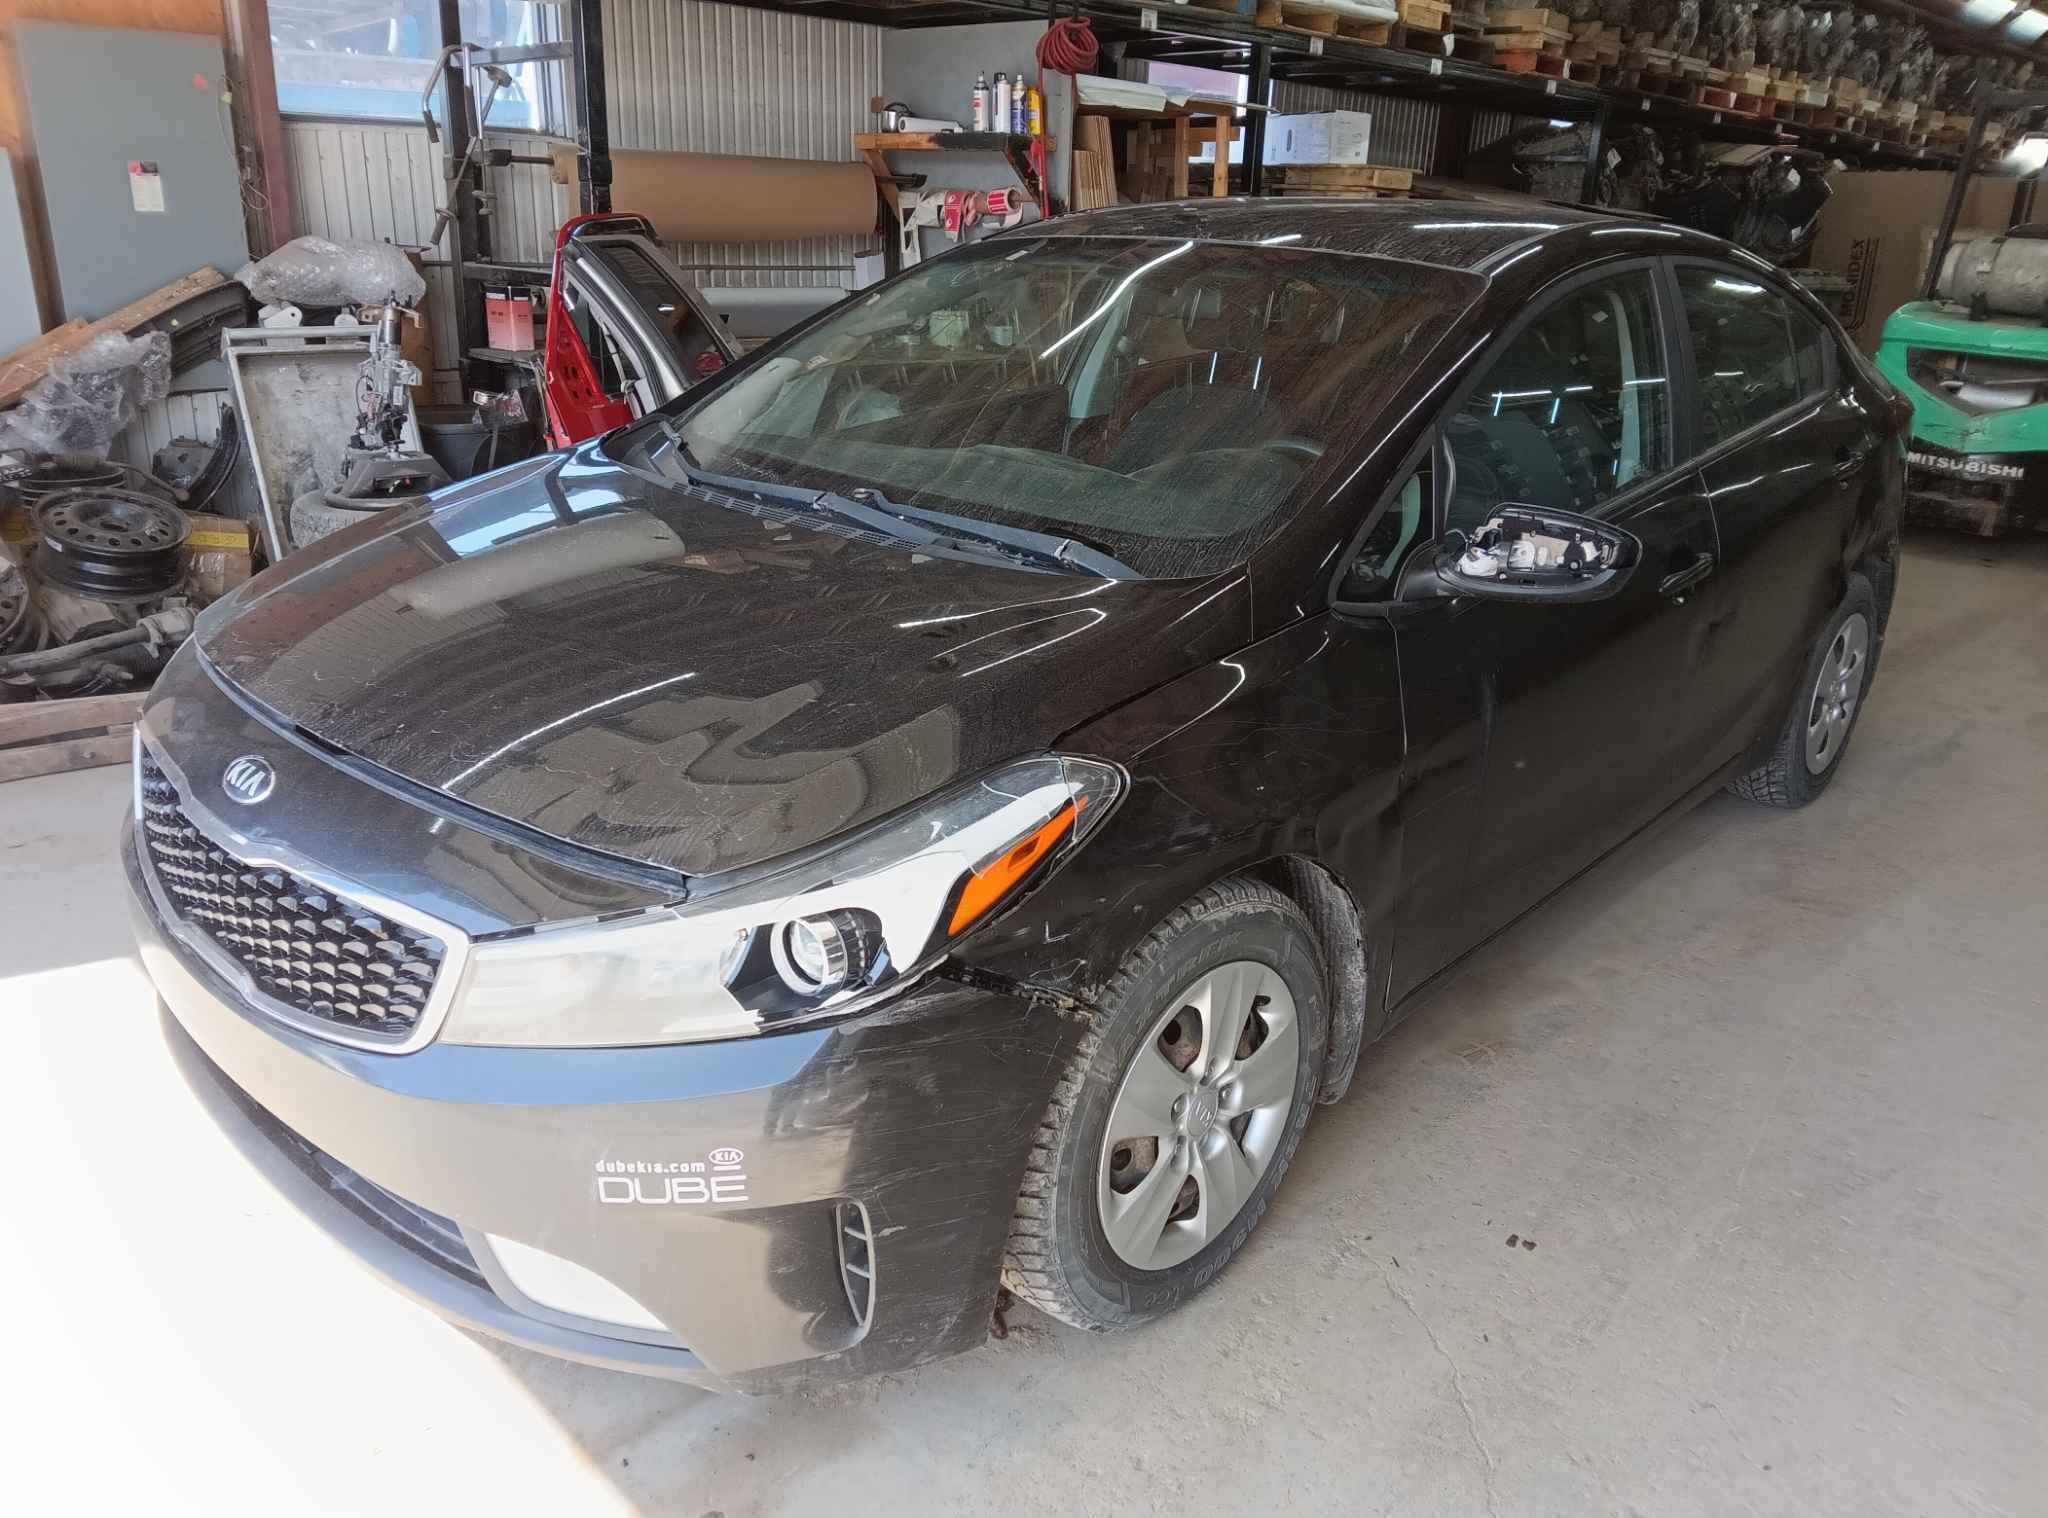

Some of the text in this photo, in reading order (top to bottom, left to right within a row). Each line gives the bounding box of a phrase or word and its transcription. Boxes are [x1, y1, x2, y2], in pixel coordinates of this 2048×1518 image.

[1906, 451, 2025, 478] MITSUBISHI
[714, 1151, 739, 1162] KIA
[595, 1160, 705, 1174] dubekia.com
[598, 1175, 749, 1204] DUBE
